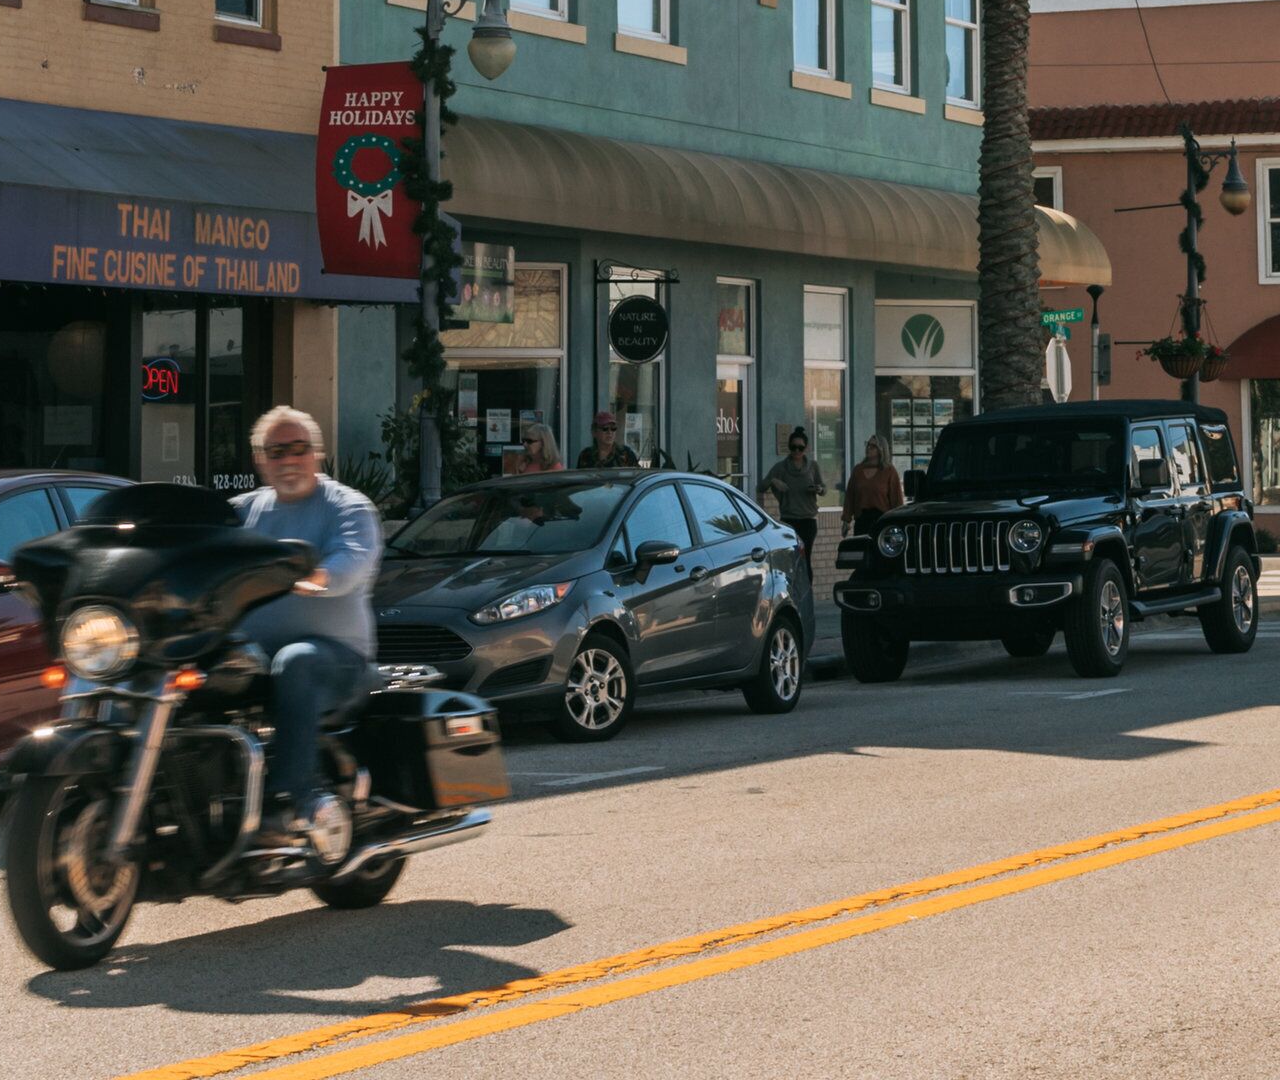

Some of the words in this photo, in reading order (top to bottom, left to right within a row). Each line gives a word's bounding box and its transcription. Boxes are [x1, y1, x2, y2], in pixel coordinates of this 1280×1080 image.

[344, 91, 404, 107] HAPPY
[328, 109, 416, 126] HOLIDAYS
[118, 203, 171, 242] THAI
[195, 213, 270, 251] MANGO
[52, 245, 98, 281] FINE
[104, 250, 176, 287] CUISINE
[183, 255, 208, 287] OF
[214, 258, 300, 293] THAILAND
[618, 312, 657, 322] NATURE
[1043, 311, 1076, 323] ORANGE
[633, 324, 643, 333] IN
[617, 336, 658, 346] BEAUTY
[213, 473, 255, 490] 428-0208
